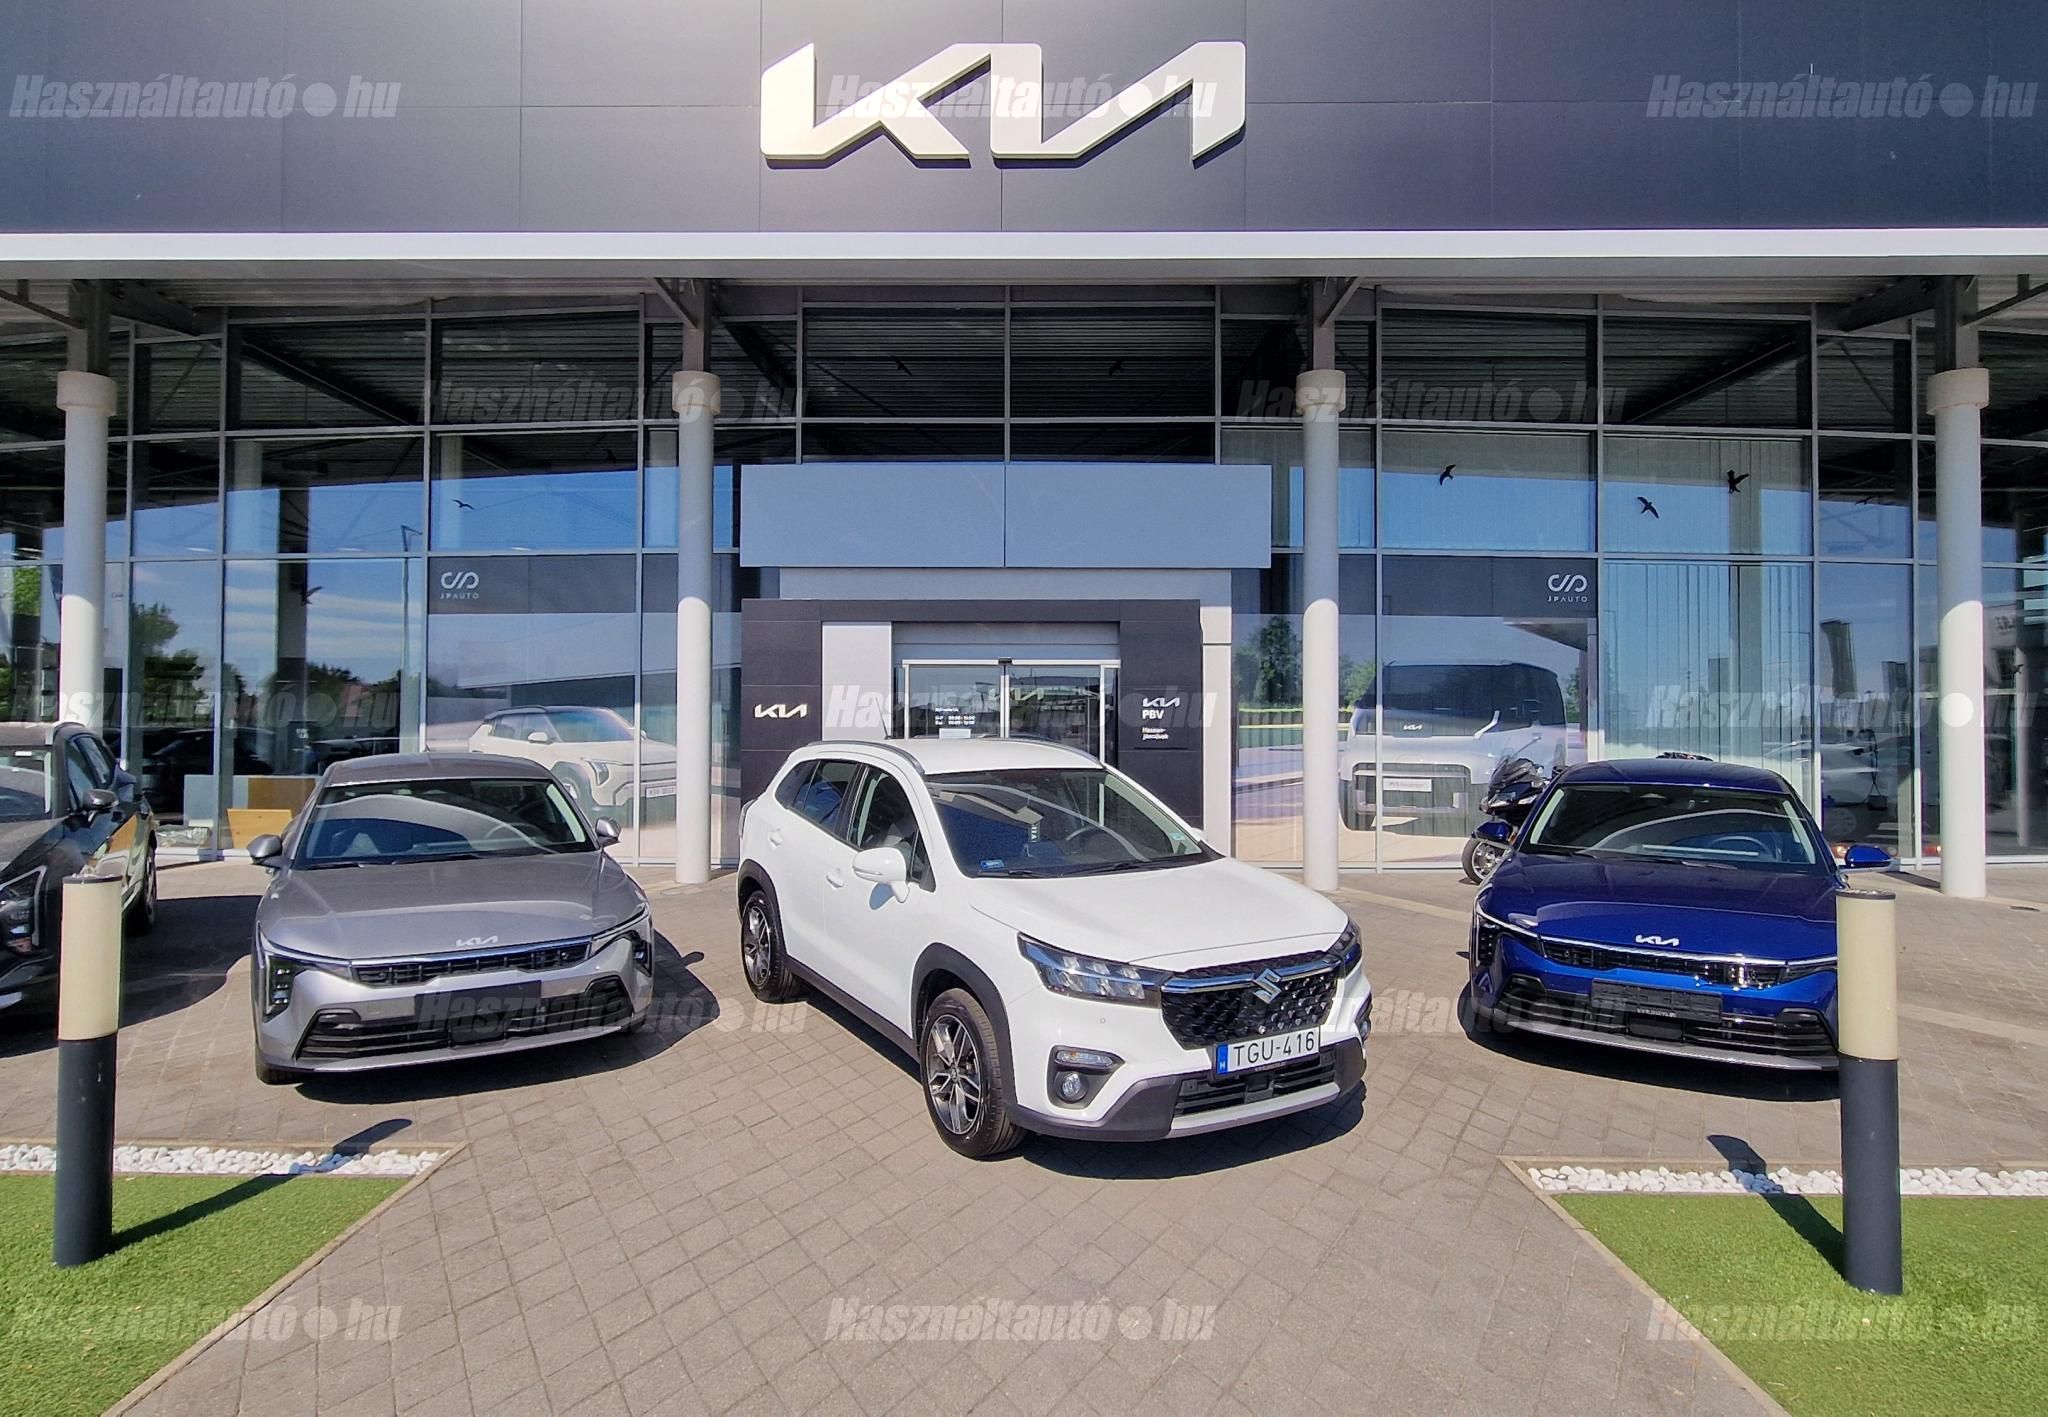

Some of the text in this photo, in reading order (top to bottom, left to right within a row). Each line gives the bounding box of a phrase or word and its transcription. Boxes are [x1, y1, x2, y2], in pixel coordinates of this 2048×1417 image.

[760, 41, 1246, 160] KIA
[1142, 697, 1181, 708] KIA
[755, 704, 808, 718] KIA
[1142, 710, 1164, 719] PBV
[1635, 934, 1680, 946] KIA
[1233, 1031, 1315, 1066] TGU-416
